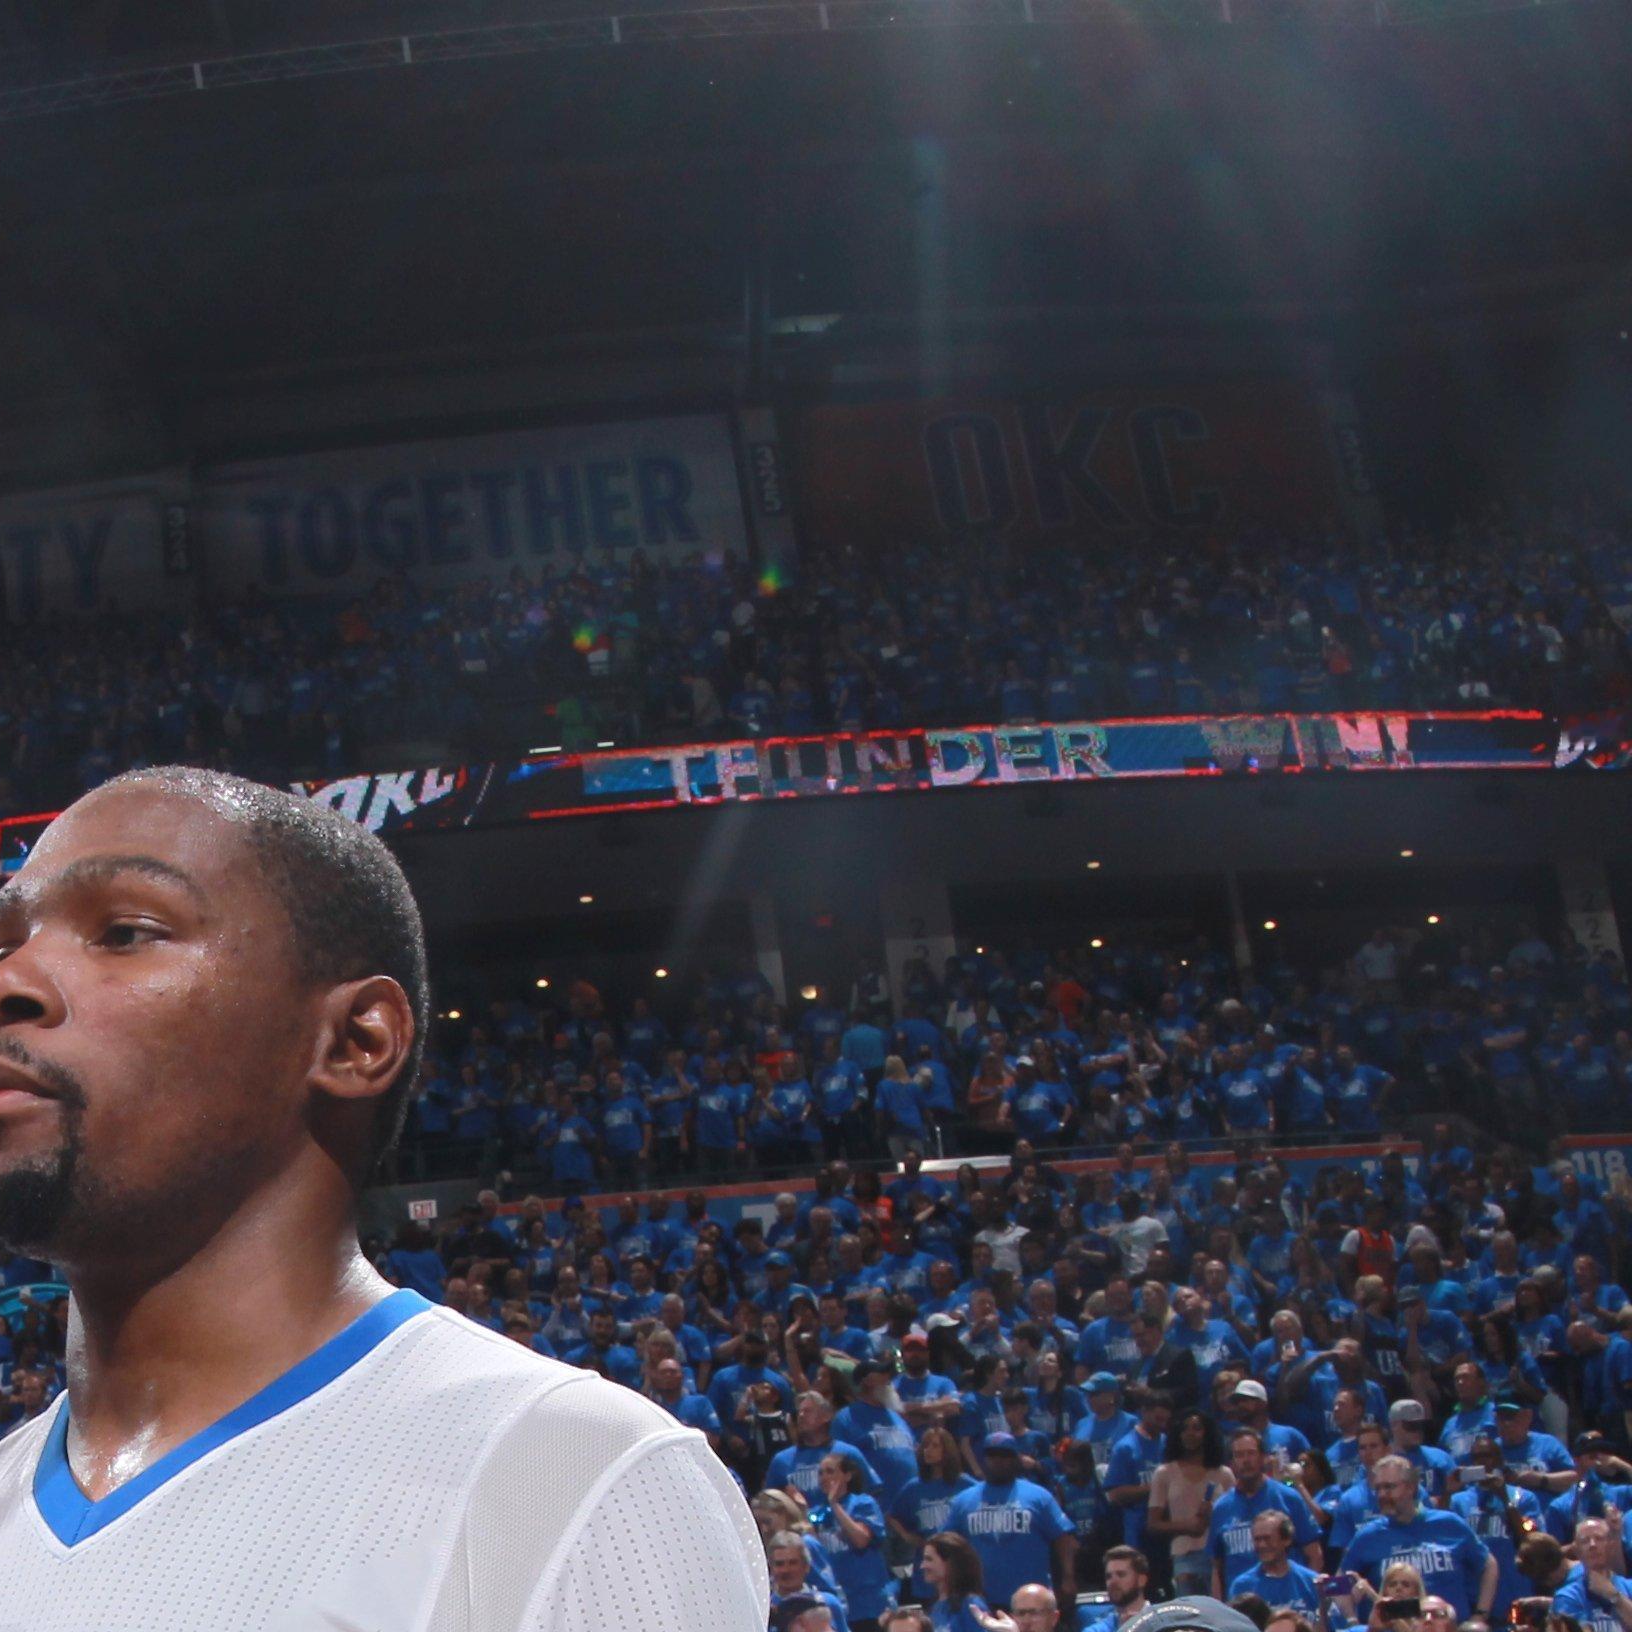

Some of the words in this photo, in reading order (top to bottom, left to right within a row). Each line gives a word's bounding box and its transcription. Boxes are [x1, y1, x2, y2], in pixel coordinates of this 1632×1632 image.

[756, 443, 781, 514] 325
[921, 402, 1226, 532] OKC
[246, 454, 700, 585] TOGETHER
[967, 1508, 1033, 1535] THUNDER
